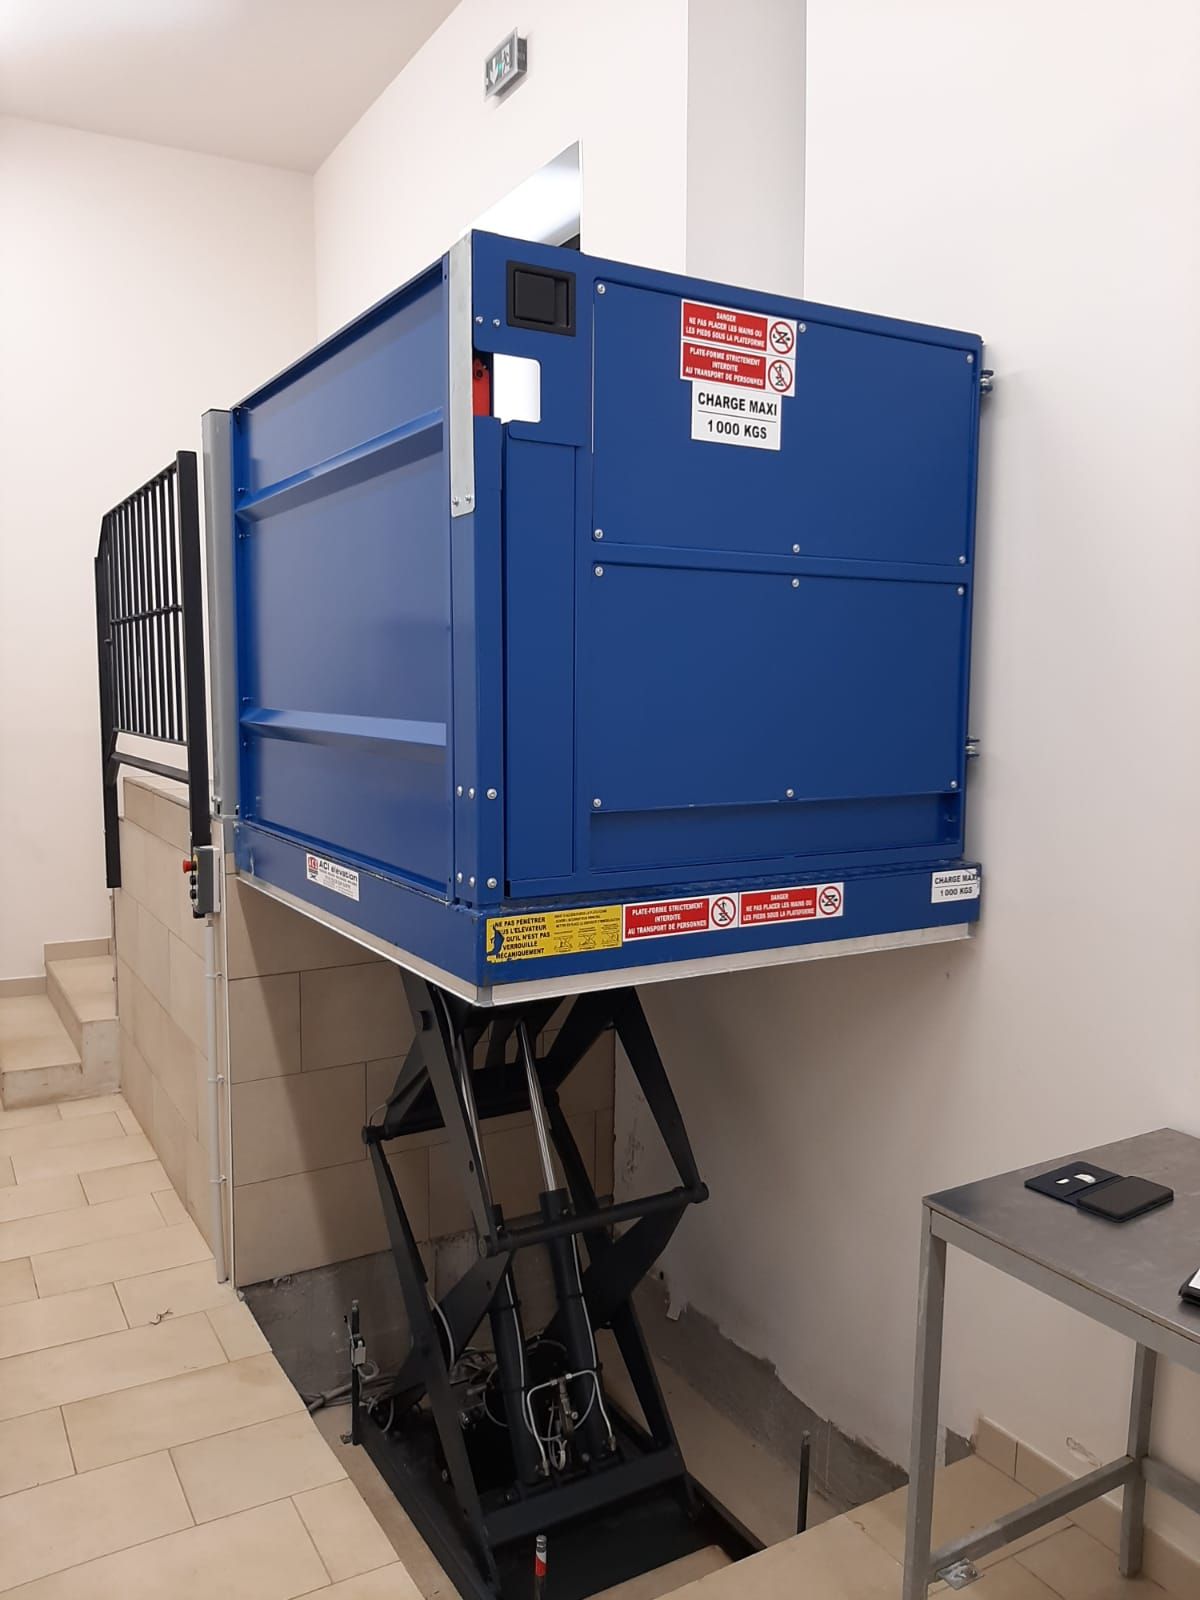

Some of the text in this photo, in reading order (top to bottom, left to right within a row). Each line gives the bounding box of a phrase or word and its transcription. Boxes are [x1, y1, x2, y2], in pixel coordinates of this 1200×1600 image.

[716, 312, 736, 322] DANGER
[688, 317, 762, 337] NE PAS PLACER LES MAINS OU
[685, 326, 765, 348] LES PIEDS SOUS LA PLATEFORME
[689, 347, 760, 366] PLATE-FORME STRICTEMENT
[712, 361, 738, 372] INTERDITE
[694, 367, 724, 379] TRANSPORT
[725, 373, 732, 381] DE
[733, 374, 763, 386] PERSONNES
[698, 392, 777, 416] CHARGE MAXI
[744, 424, 767, 439] KGS
[319, 861, 330, 870] ACI
[935, 875, 960, 884] CHARGE
[770, 893, 789, 901] DANGER
[632, 902, 703, 916] PLATE-FORME STRICTEMENT
[655, 914, 681, 923] INTERDITE
[628, 928, 636, 936] AU
[637, 923, 667, 934] TRANSPORT
[677, 920, 707, 929] PERSONNES
